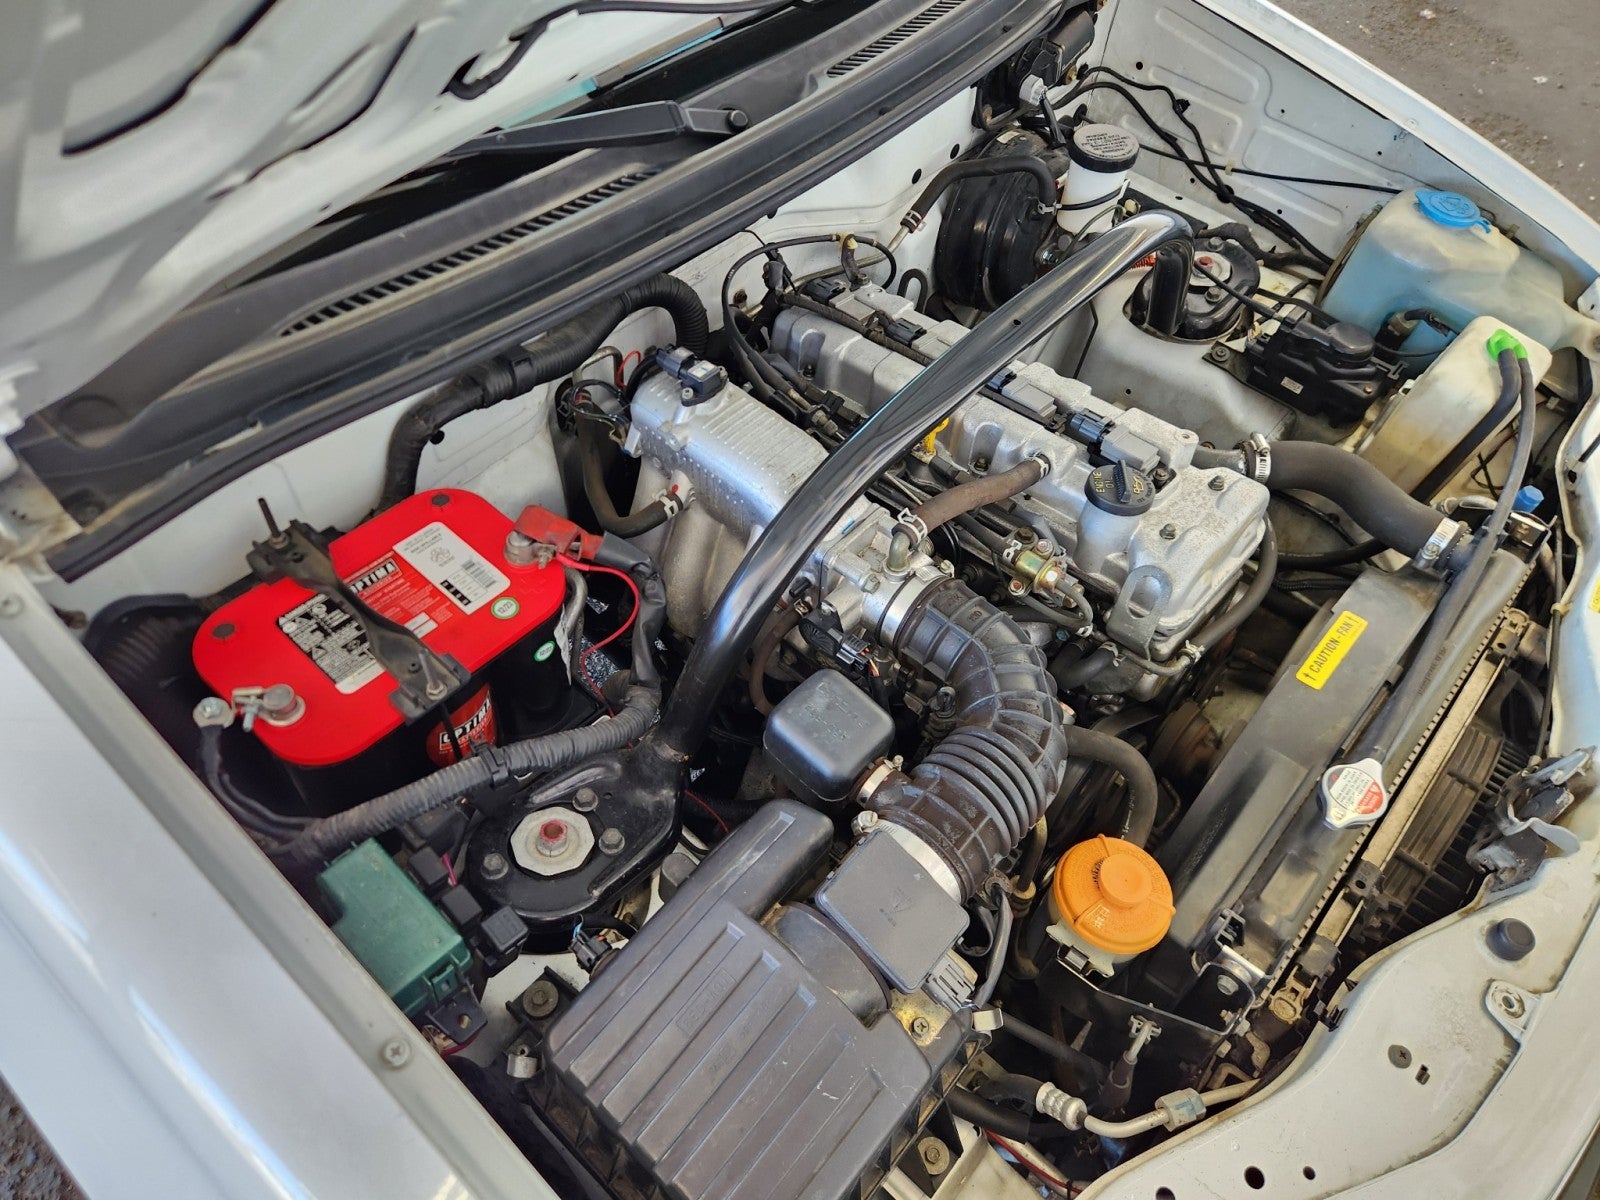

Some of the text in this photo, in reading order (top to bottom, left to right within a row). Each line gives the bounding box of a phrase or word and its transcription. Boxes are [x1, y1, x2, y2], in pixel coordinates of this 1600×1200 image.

[1093, 471, 1105, 493] ENGINE
[1105, 476, 1115, 489] OIL
[1309, 637, 1341, 673] CAUTION
[1336, 621, 1353, 637] FAN
